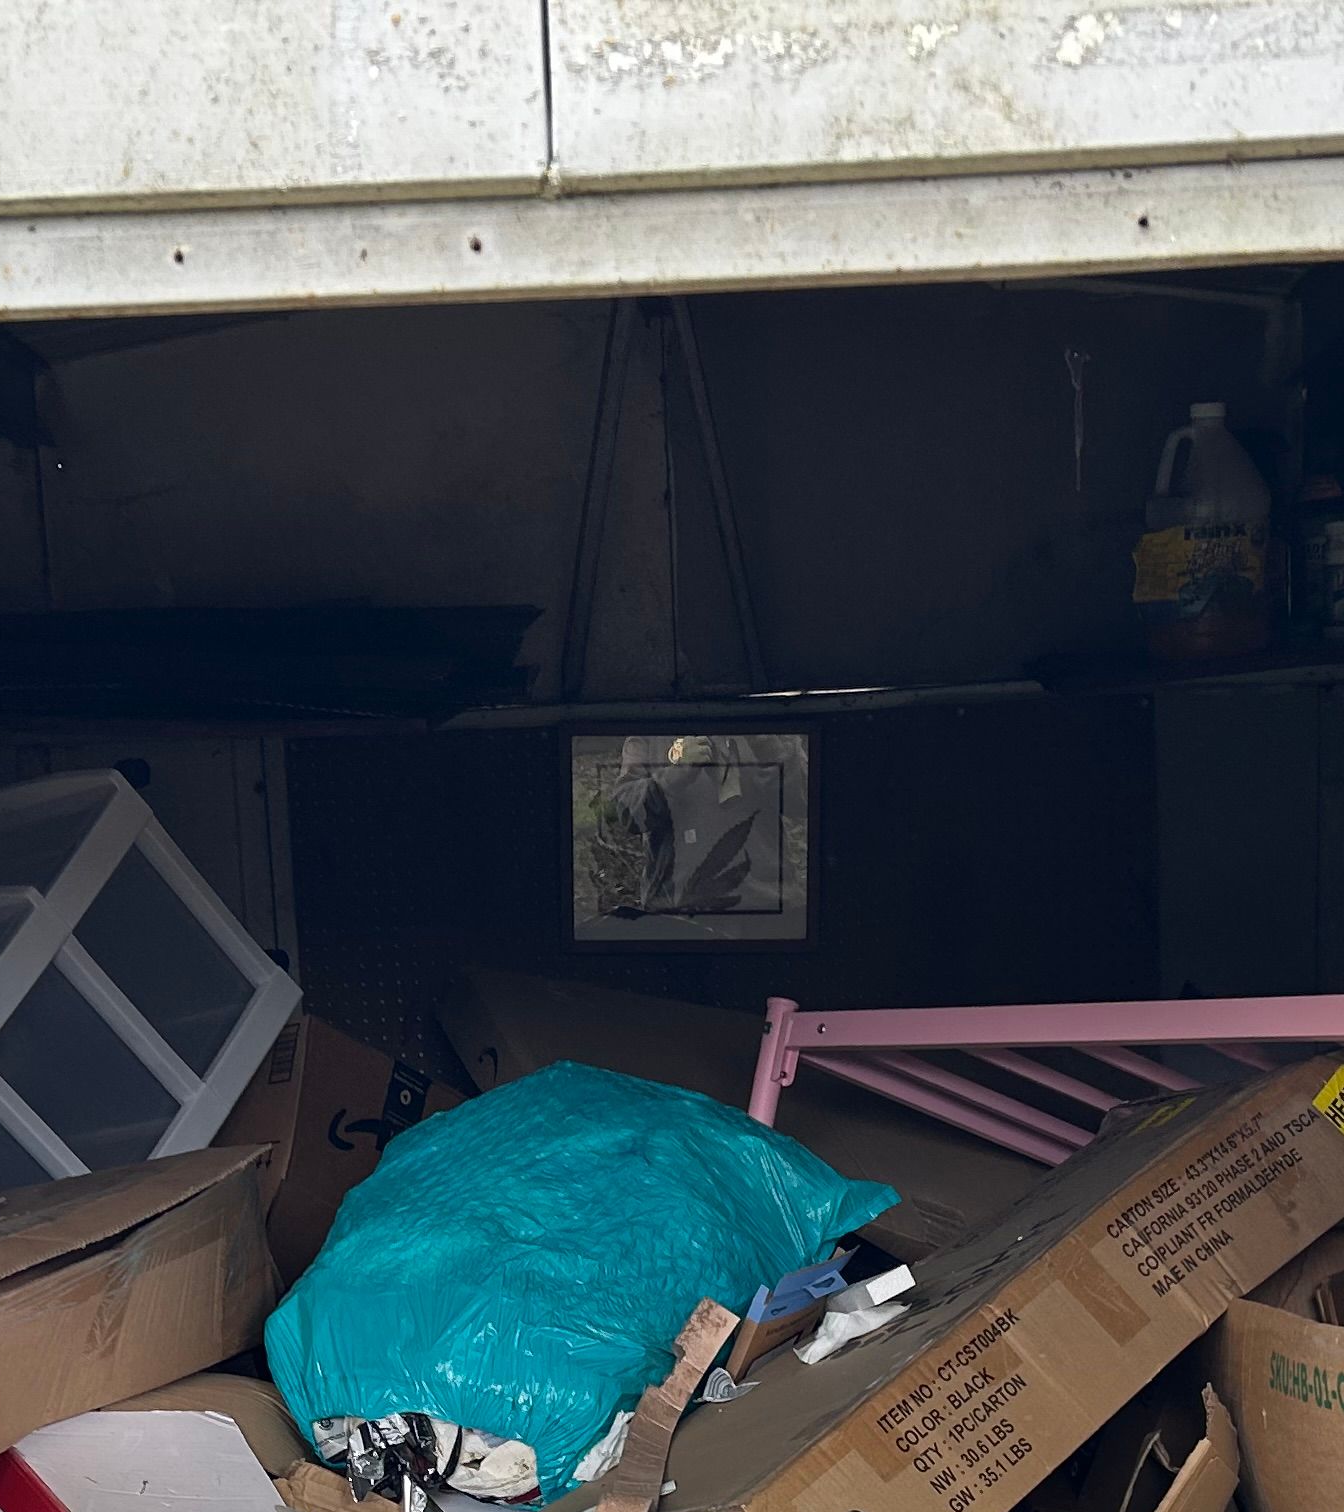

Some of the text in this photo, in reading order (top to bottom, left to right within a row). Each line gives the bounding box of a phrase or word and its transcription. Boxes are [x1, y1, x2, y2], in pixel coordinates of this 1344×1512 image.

[1185, 1183, 1219, 1211] 93120
[1215, 1156, 1255, 1190] PHASE
[1252, 1146, 1264, 1162] 2
[1261, 1131, 1287, 1162] AND
[1282, 1107, 1320, 1138] TSCA
[1107, 1195, 1157, 1240] CARTON
[1152, 1177, 1181, 1207] SIZE
[1137, 1148, 1303, 1278] COPLIANT FR FORMALDEHYDE
[1152, 1229, 1234, 1299] MAE IN CHINA
[876, 1308, 1021, 1434] ITEM NO CT-CST004BK
[895, 1366, 996, 1453] COLOR BLACK
[913, 1374, 1028, 1473] QTY 1PC/CARTON
[929, 1418, 1015, 1495] NW 30.6 LBS
[978, 1459, 1008, 1488] 35.1
[1003, 1437, 1033, 1466] LBS
